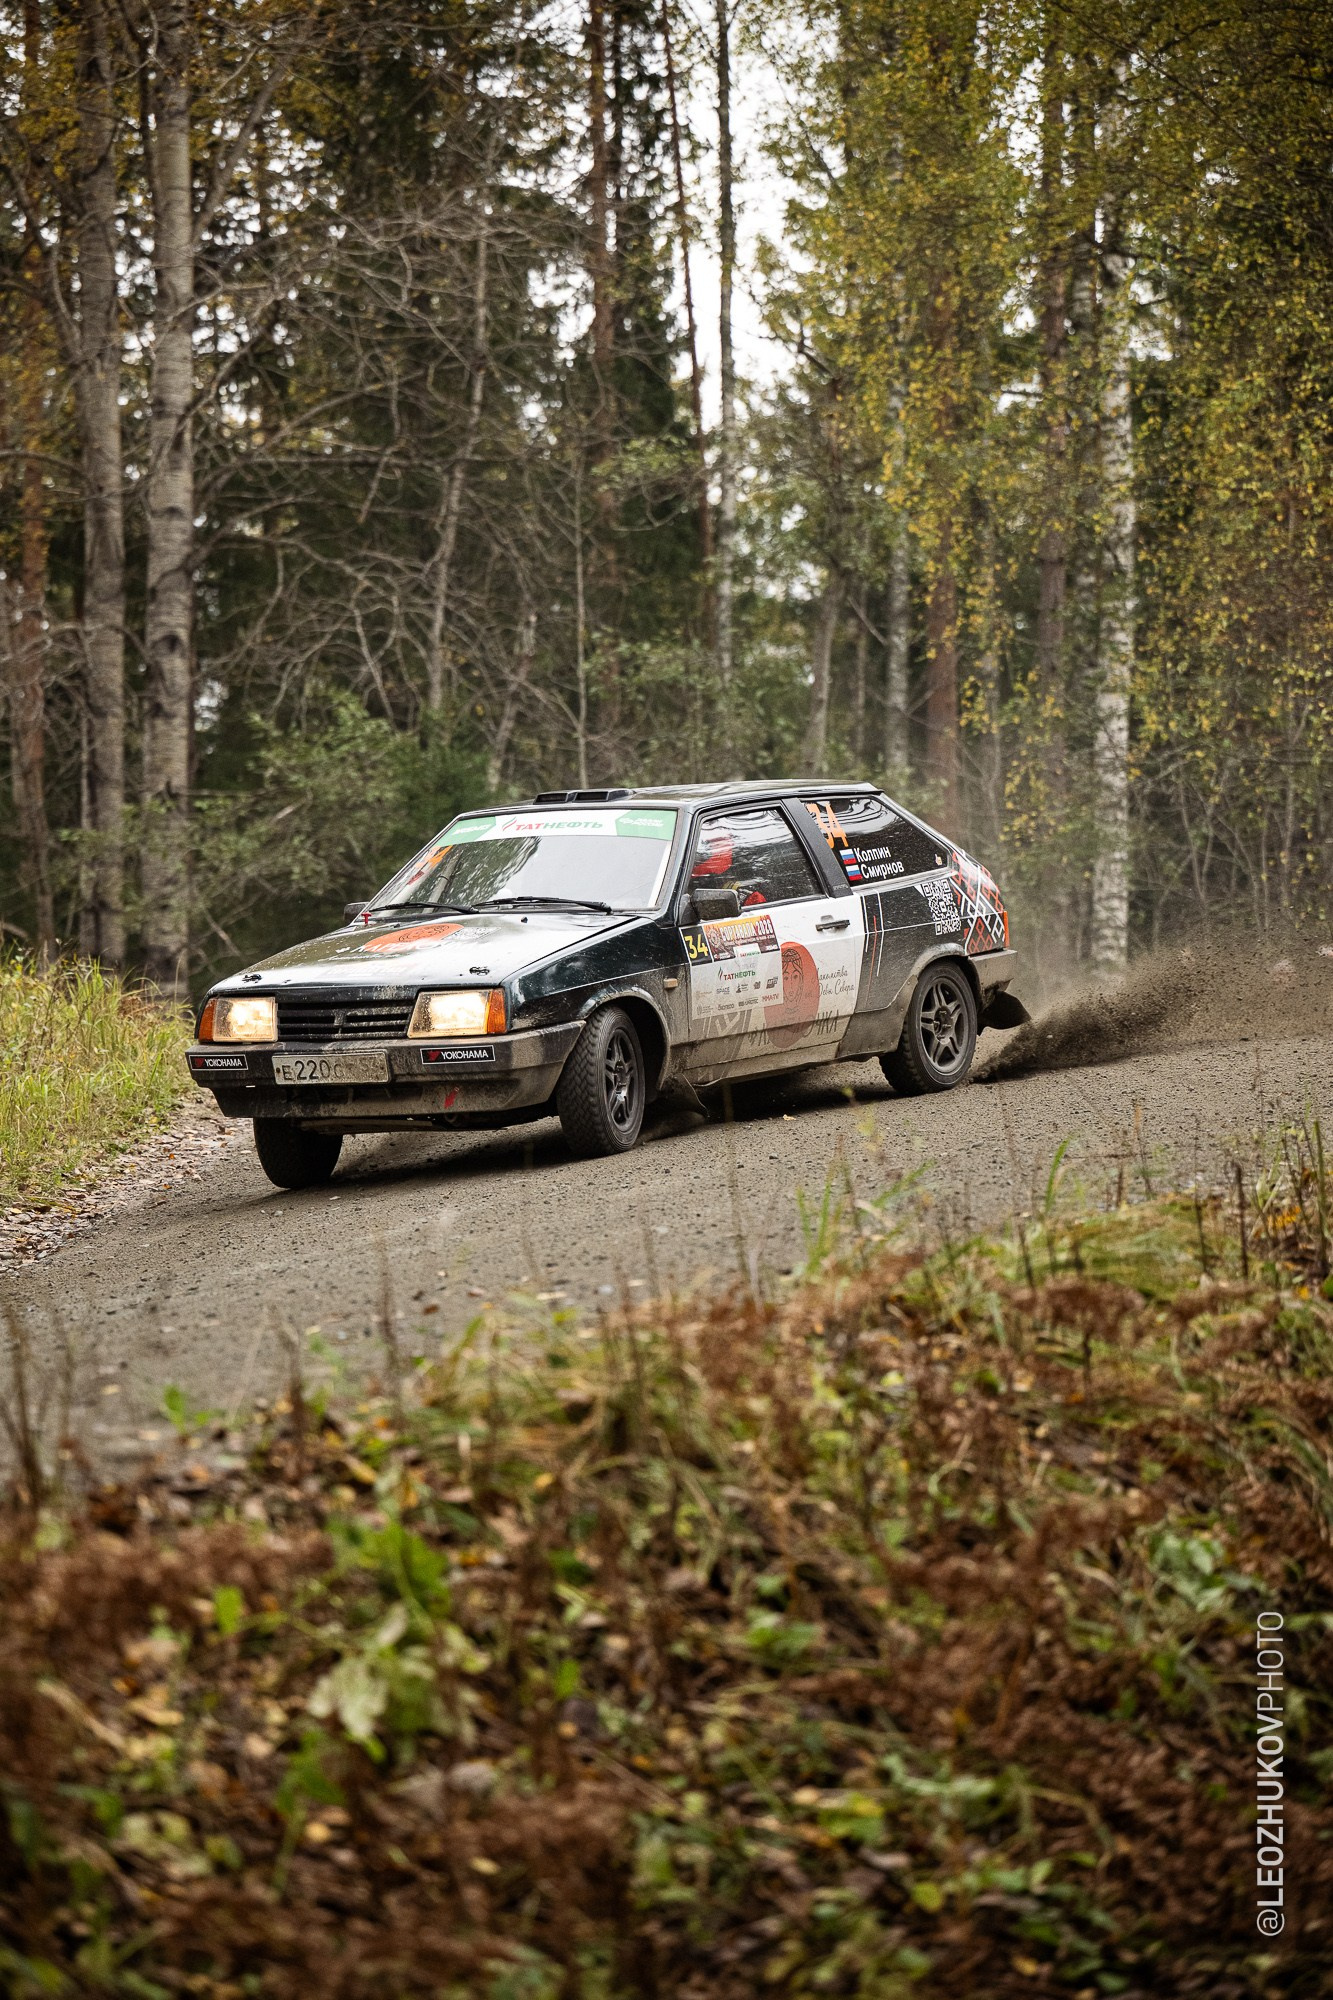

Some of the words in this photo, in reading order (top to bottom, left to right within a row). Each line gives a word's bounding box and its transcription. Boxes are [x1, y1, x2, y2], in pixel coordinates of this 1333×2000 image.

[515, 822, 603, 831] ТАТНЕФТЬ
[806, 802, 849, 849] 34
[853, 846, 892, 863] Колпин
[860, 861, 905, 879] Смирнов
[684, 934, 709, 959] 34
[723, 970, 756, 981] ТАТНЕФТЬ
[441, 1049, 489, 1060] YOKOHAMA
[205, 1057, 243, 1067] YOKOHAMA
